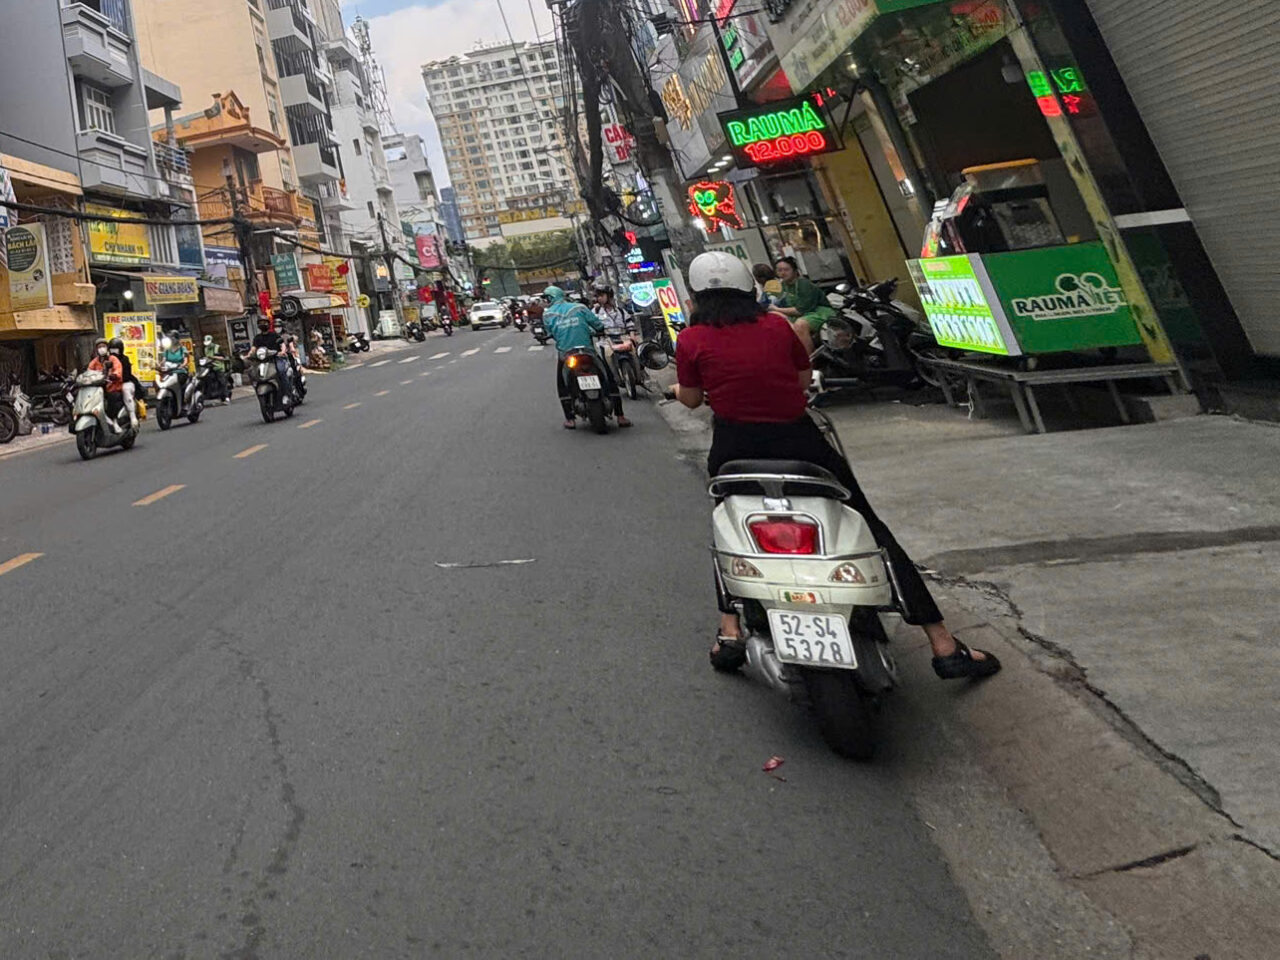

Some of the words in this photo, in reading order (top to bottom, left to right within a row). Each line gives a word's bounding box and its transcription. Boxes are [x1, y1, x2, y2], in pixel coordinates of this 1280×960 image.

[727, 101, 824, 146] RAUMÁ
[744, 130, 827, 162] 12.000
[780, 614, 837, 639] 52-S4
[784, 637, 844, 664] 5328
